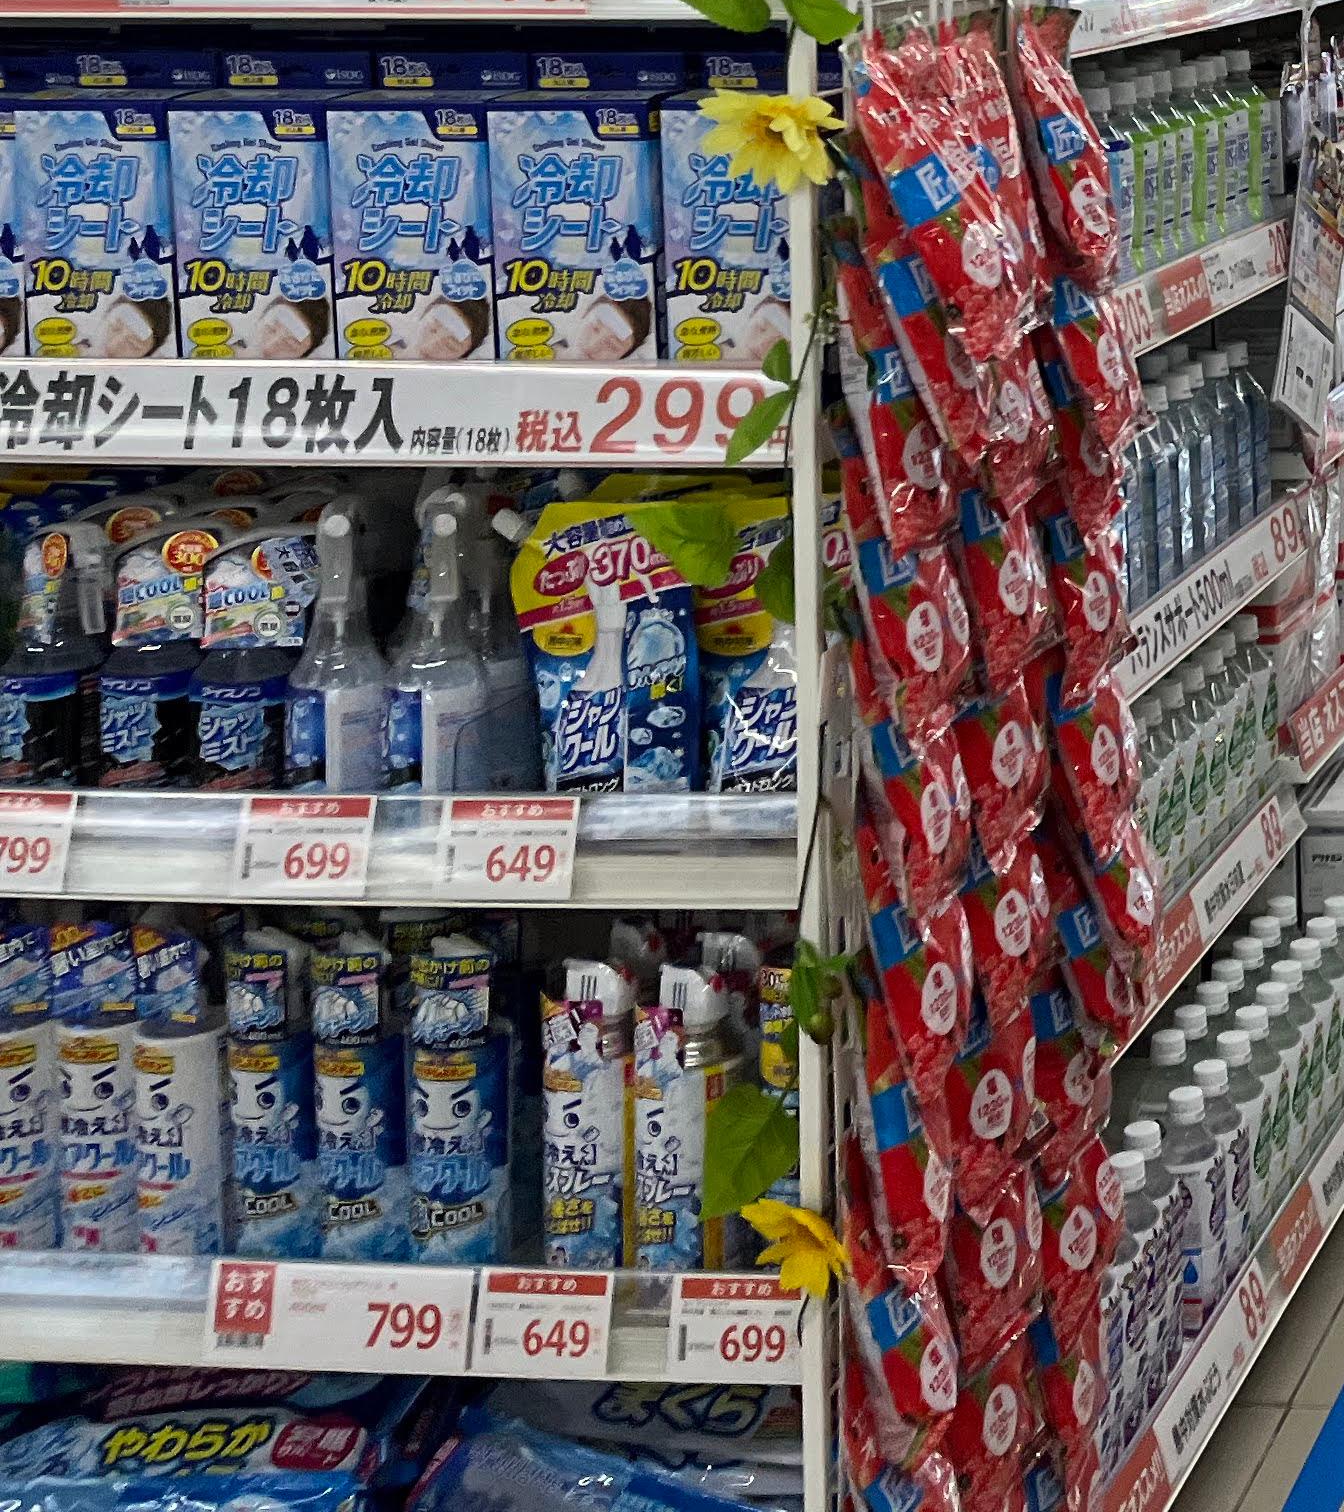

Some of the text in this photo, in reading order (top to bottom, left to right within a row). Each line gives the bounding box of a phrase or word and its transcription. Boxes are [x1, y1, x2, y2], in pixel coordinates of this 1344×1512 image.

[37, 152, 141, 207] 冷却
[192, 152, 298, 207] 冷却
[351, 151, 461, 207] 冷却
[513, 152, 623, 208] 冷却
[44, 204, 141, 253] シート
[199, 204, 300, 253] シート
[357, 204, 464, 253] シート
[521, 205, 622, 253] シート
[689, 205, 790, 253] シート
[0, 370, 405, 454] 冷却シート18枚入
[515, 409, 583, 454] 税込
[1269, 506, 1300, 562] 89
[135, 574, 182, 602] COOL
[224, 582, 270, 608] COOL
[567, 689, 622, 732] シャツ
[562, 726, 621, 771] クール
[284, 841, 351, 880] 699
[486, 843, 556, 883] 649
[246, 1193, 293, 1216] COOL
[430, 1201, 483, 1228] COOL
[223, 1266, 267, 1294] おす
[221, 1294, 267, 1322] すめ
[365, 1301, 442, 1352] 799
[1238, 1271, 1268, 1341] 89
[521, 1319, 591, 1359] 649
[719, 1323, 787, 1364] 699
[103, 1414, 275, 1465] やわらか
